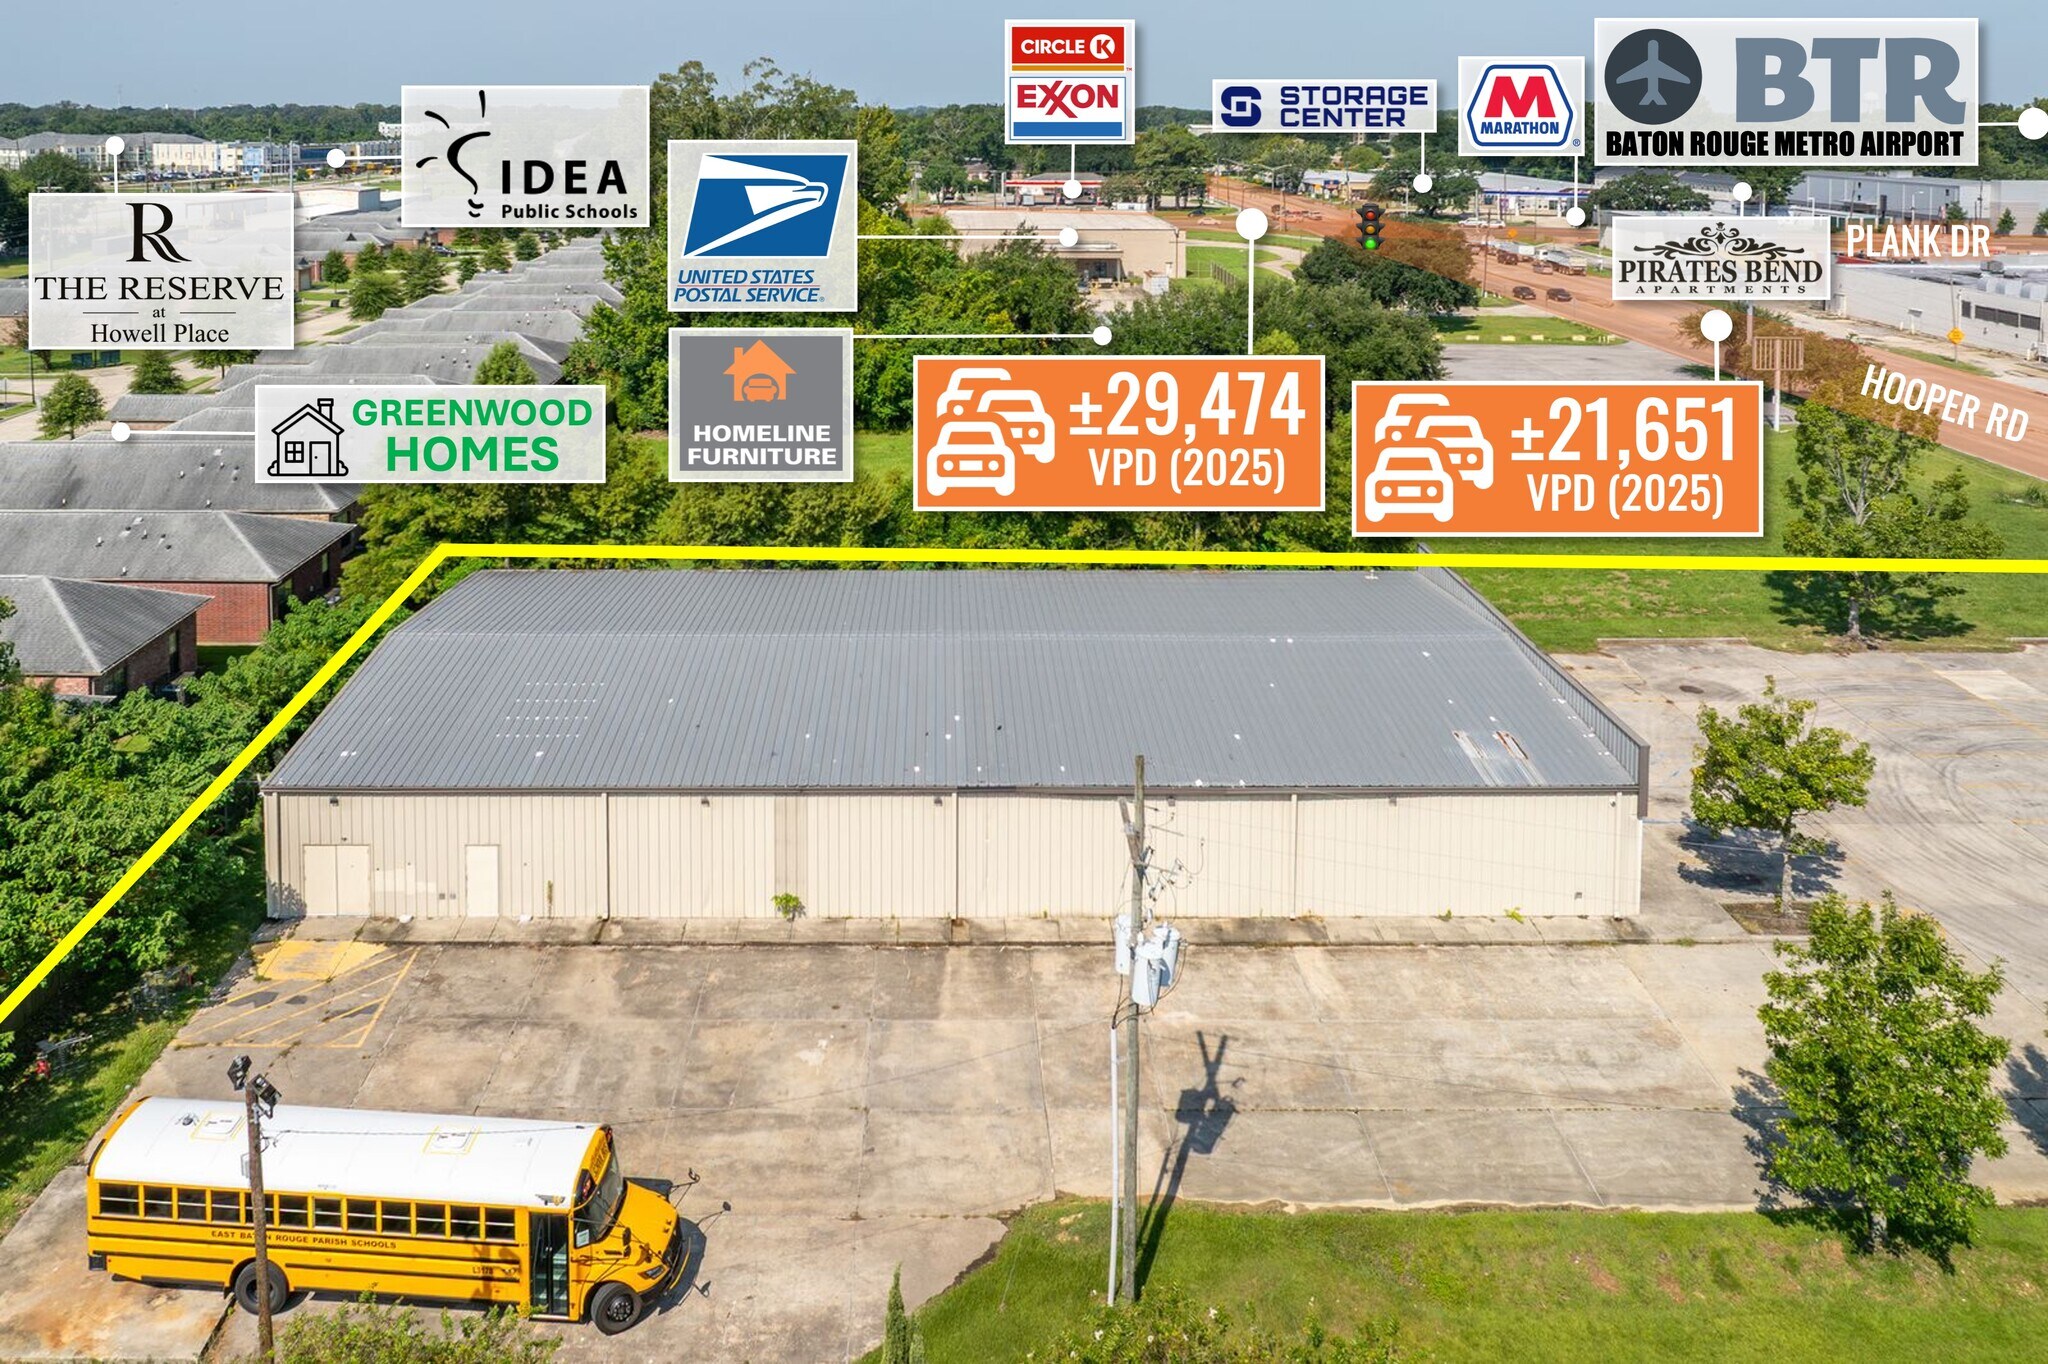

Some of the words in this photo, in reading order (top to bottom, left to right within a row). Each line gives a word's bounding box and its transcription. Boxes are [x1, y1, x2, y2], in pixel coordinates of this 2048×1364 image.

[211, 1230, 236, 1239] EAST
[240, 1231, 271, 1241] BAN
[275, 1234, 309, 1243] ROUGE
[312, 1236, 348, 1246] PARISH
[351, 1239, 397, 1249] SCHOOLS
